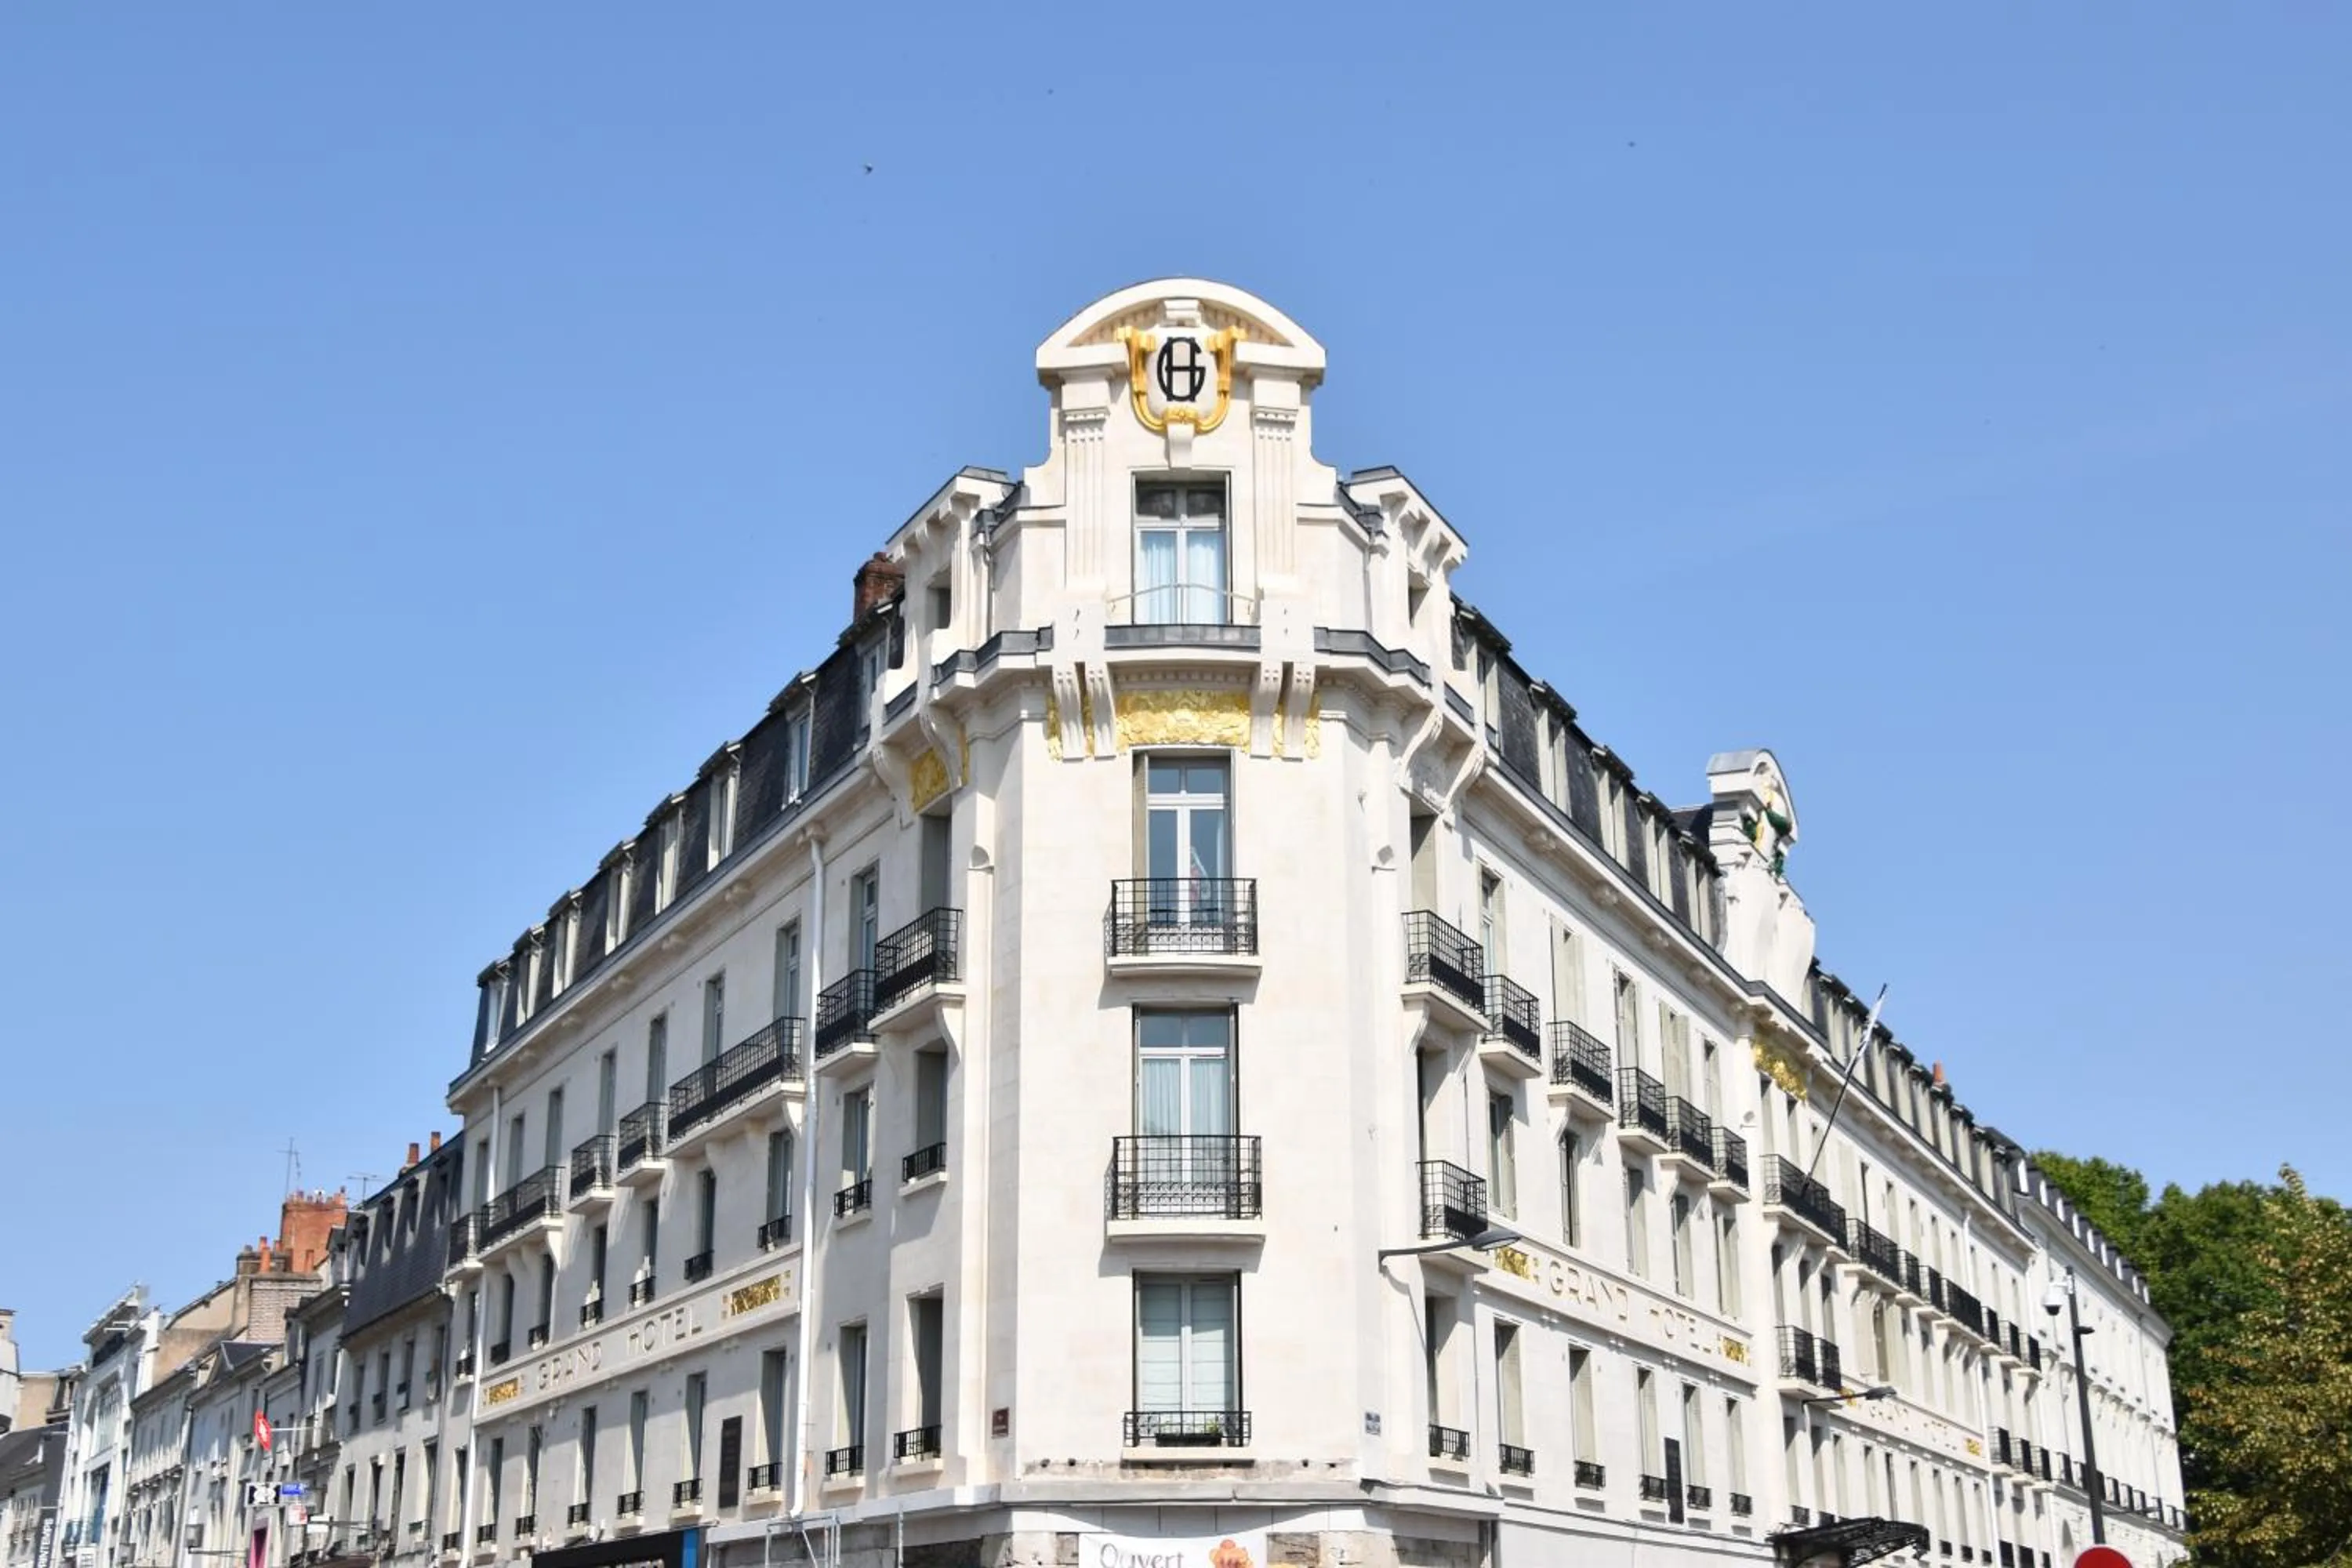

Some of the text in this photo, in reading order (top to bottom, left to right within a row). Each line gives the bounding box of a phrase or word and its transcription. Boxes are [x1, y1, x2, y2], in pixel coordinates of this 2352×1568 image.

[536, 1304, 703, 1392] GRAND HOTEL
[1548, 1259, 1713, 1355] GRAND HOTEL
[1100, 1542, 1185, 1568] Ouvert
